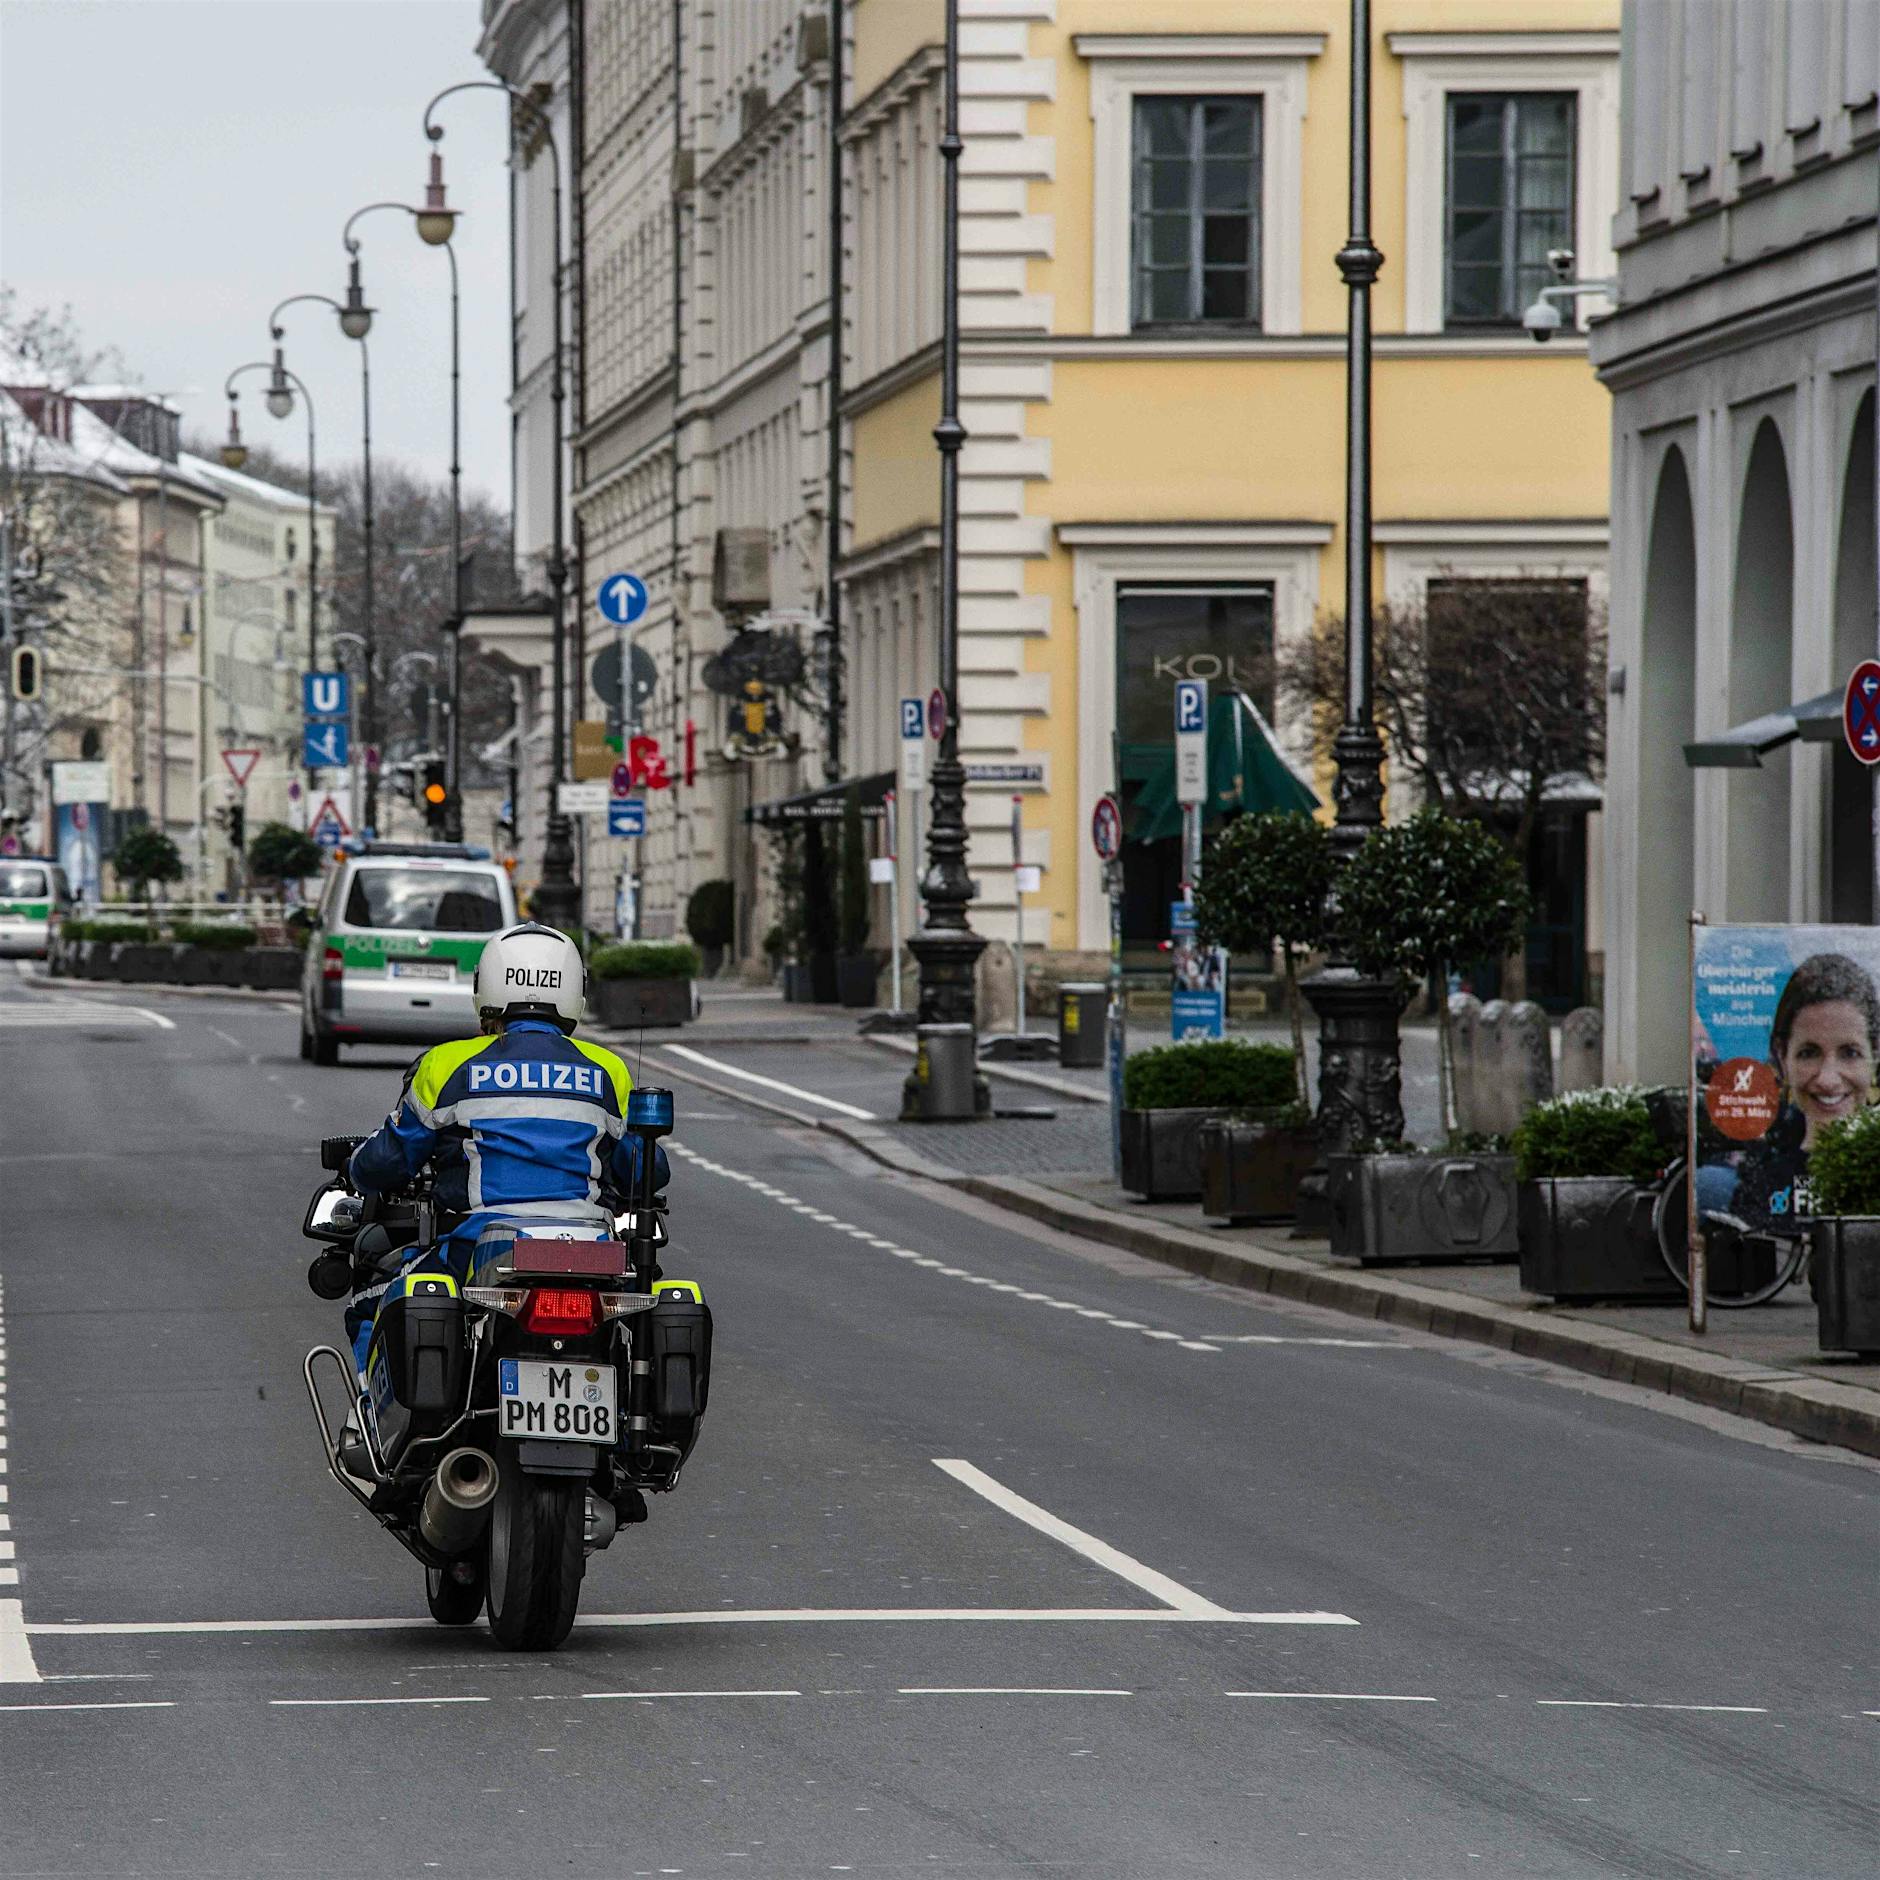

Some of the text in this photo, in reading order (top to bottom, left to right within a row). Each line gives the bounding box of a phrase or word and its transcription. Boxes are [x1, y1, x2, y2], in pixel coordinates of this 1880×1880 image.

[313, 677, 340, 712] U
[903, 702, 920, 735] P
[1180, 687, 1199, 729] P
[1731, 945, 1752, 957] Die
[505, 967, 562, 988] POLIZEI
[1708, 982, 1776, 995] meisterin
[1711, 1012, 1773, 1026] München
[1730, 1001, 1754, 1011] aus
[471, 1062, 603, 1095] POLIZEI
[505, 1381, 514, 1391] D
[549, 1367, 571, 1399] M
[506, 1399, 610, 1436] PM 808
